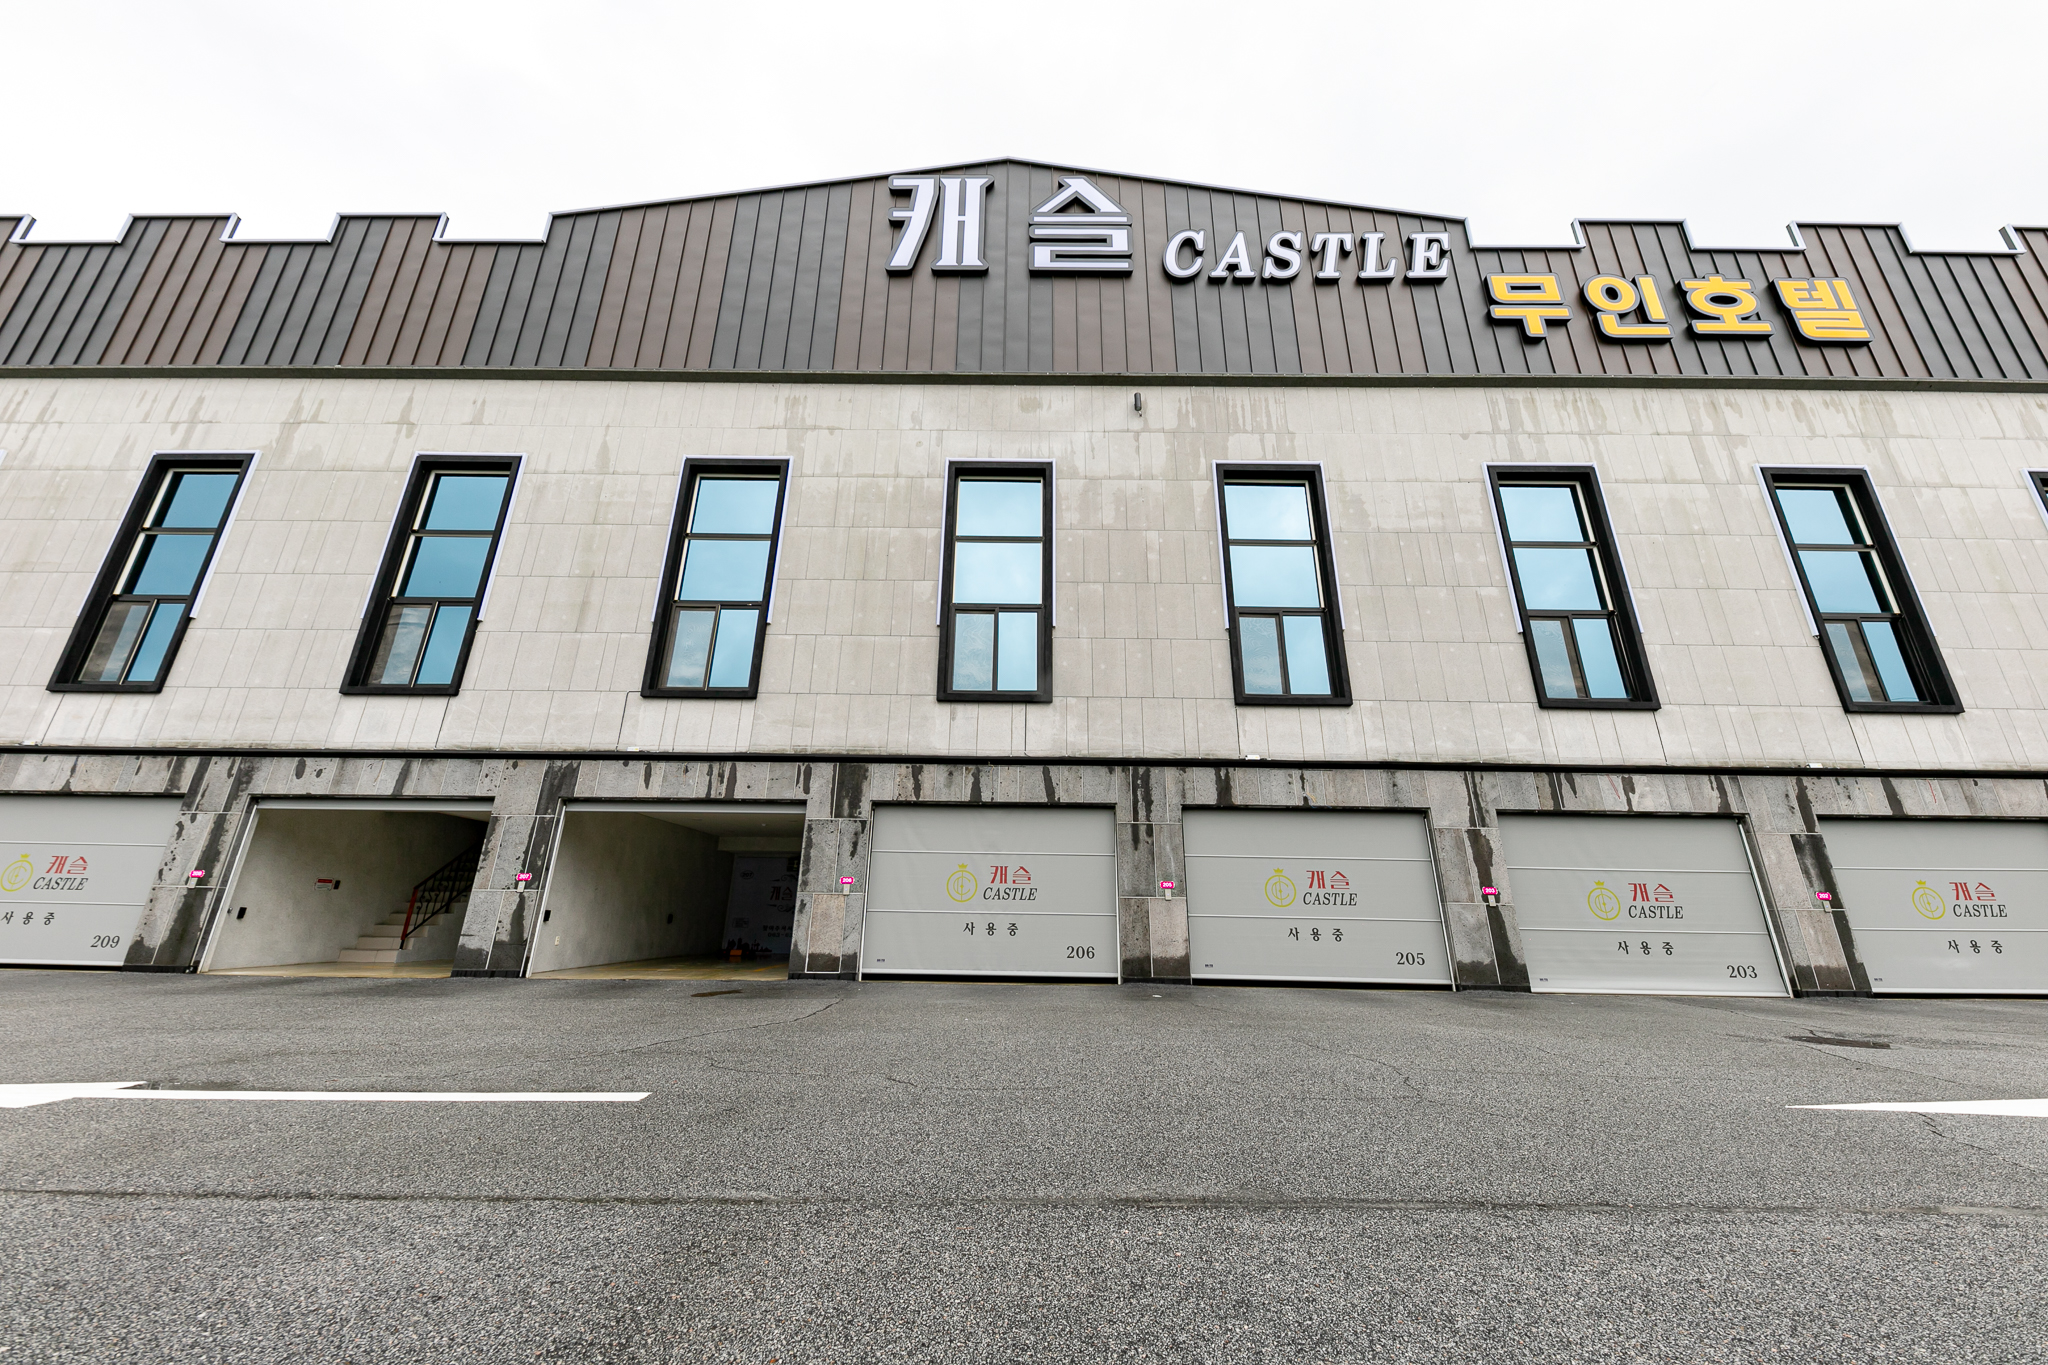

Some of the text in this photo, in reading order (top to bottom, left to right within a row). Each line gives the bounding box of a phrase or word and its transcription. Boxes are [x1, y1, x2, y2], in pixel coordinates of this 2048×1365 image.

[887, 174, 1133, 276] 캐슬
[1163, 228, 1451, 281] CASTLE
[1484, 272, 1875, 344] 무인호텔
[45, 855, 89, 875] 캐슬
[990, 865, 1032, 885] 캐슬
[1306, 870, 1350, 890] 캐슬
[32, 876, 89, 891] CASTLE
[1949, 881, 1997, 902] 캐슬
[770, 886, 793, 901] 캐슬
[983, 886, 1038, 901] CASTLE
[1302, 891, 1358, 907] CASTLE
[1627, 882, 1675, 903] 캐슬
[1628, 904, 1684, 920] CASTLE
[1952, 903, 2008, 918] CASTLE
[90, 934, 120, 949] 209
[1066, 945, 1096, 960] 206
[1395, 951, 1426, 966] 205
[1726, 964, 1758, 979] 203
